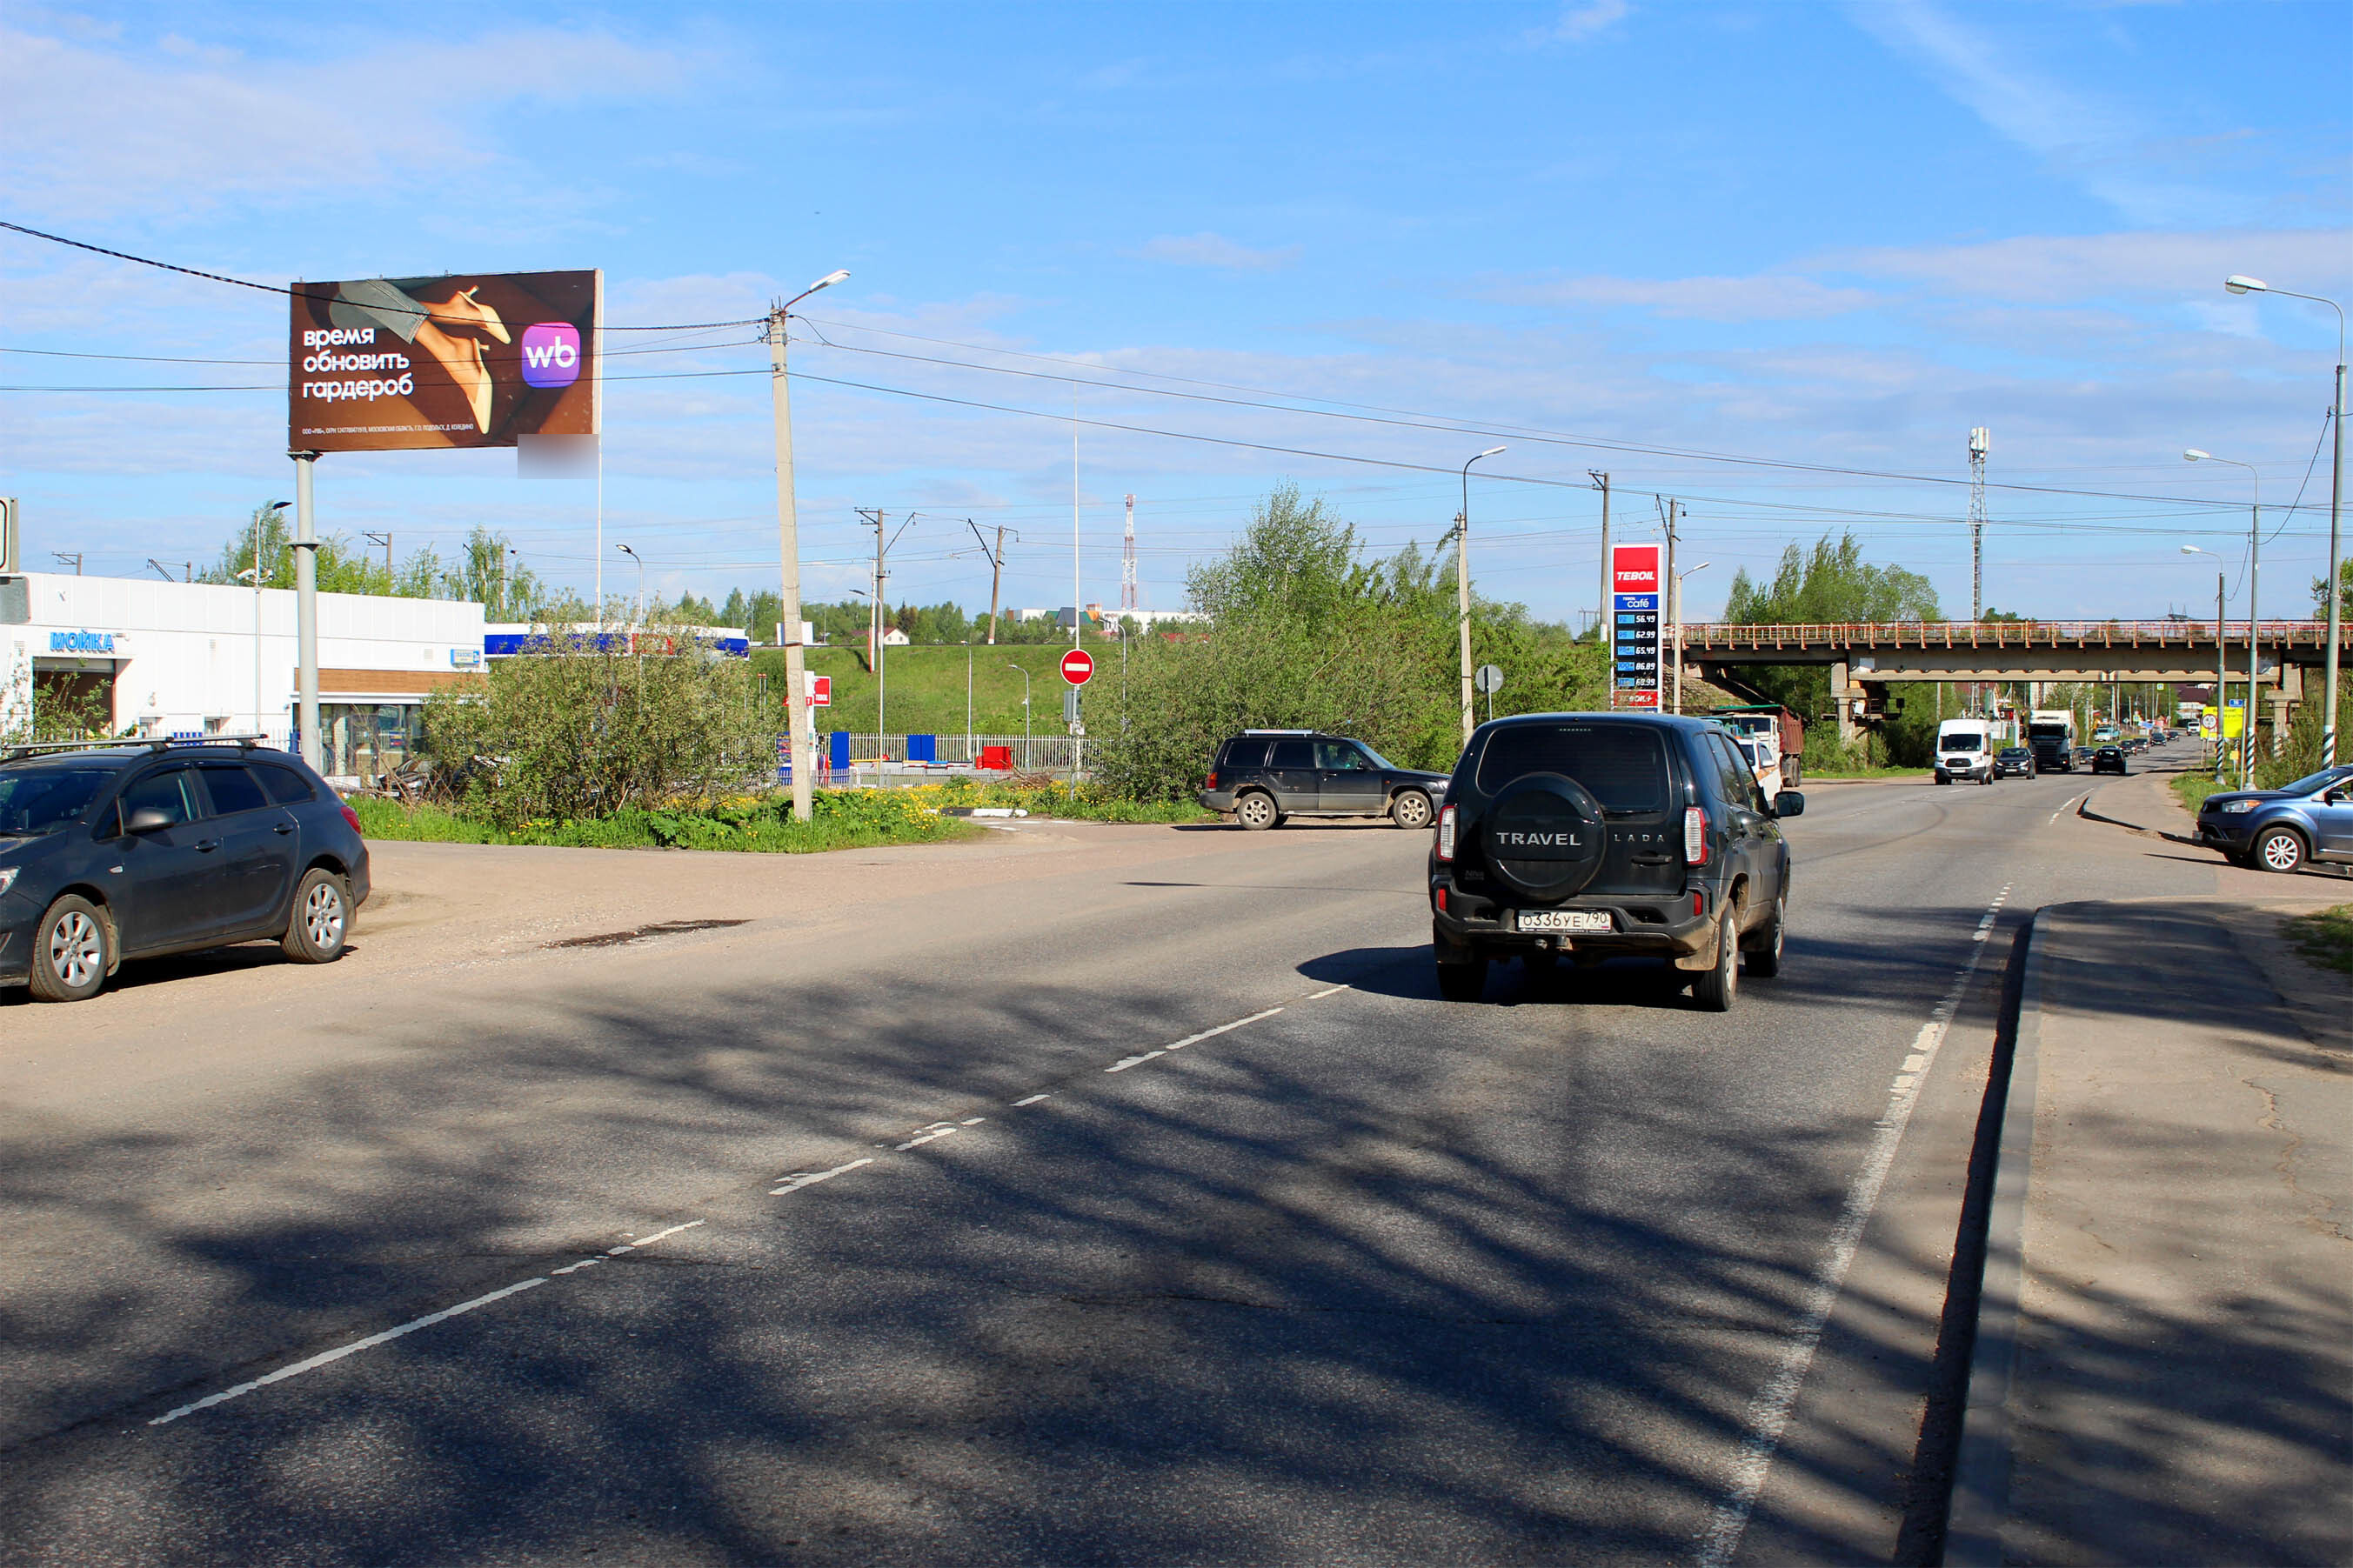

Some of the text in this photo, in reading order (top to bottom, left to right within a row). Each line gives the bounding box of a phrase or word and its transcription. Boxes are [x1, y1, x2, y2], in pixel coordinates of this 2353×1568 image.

[303, 328, 375, 351] время
[525, 336, 577, 369] wb
[303, 349, 410, 372] обновить
[302, 372, 414, 403] гардероб
[1617, 570, 1655, 581] TEBOIL
[1628, 597, 1649, 608] café
[50, 628, 115, 651] МОЙКА
[1635, 631, 1656, 639] 62.99
[1635, 646, 1656, 655] 65.49
[1496, 831, 1582, 846] TRAVEL
[1614, 834, 1665, 843] LADA
[1584, 912, 1608, 924] 790
